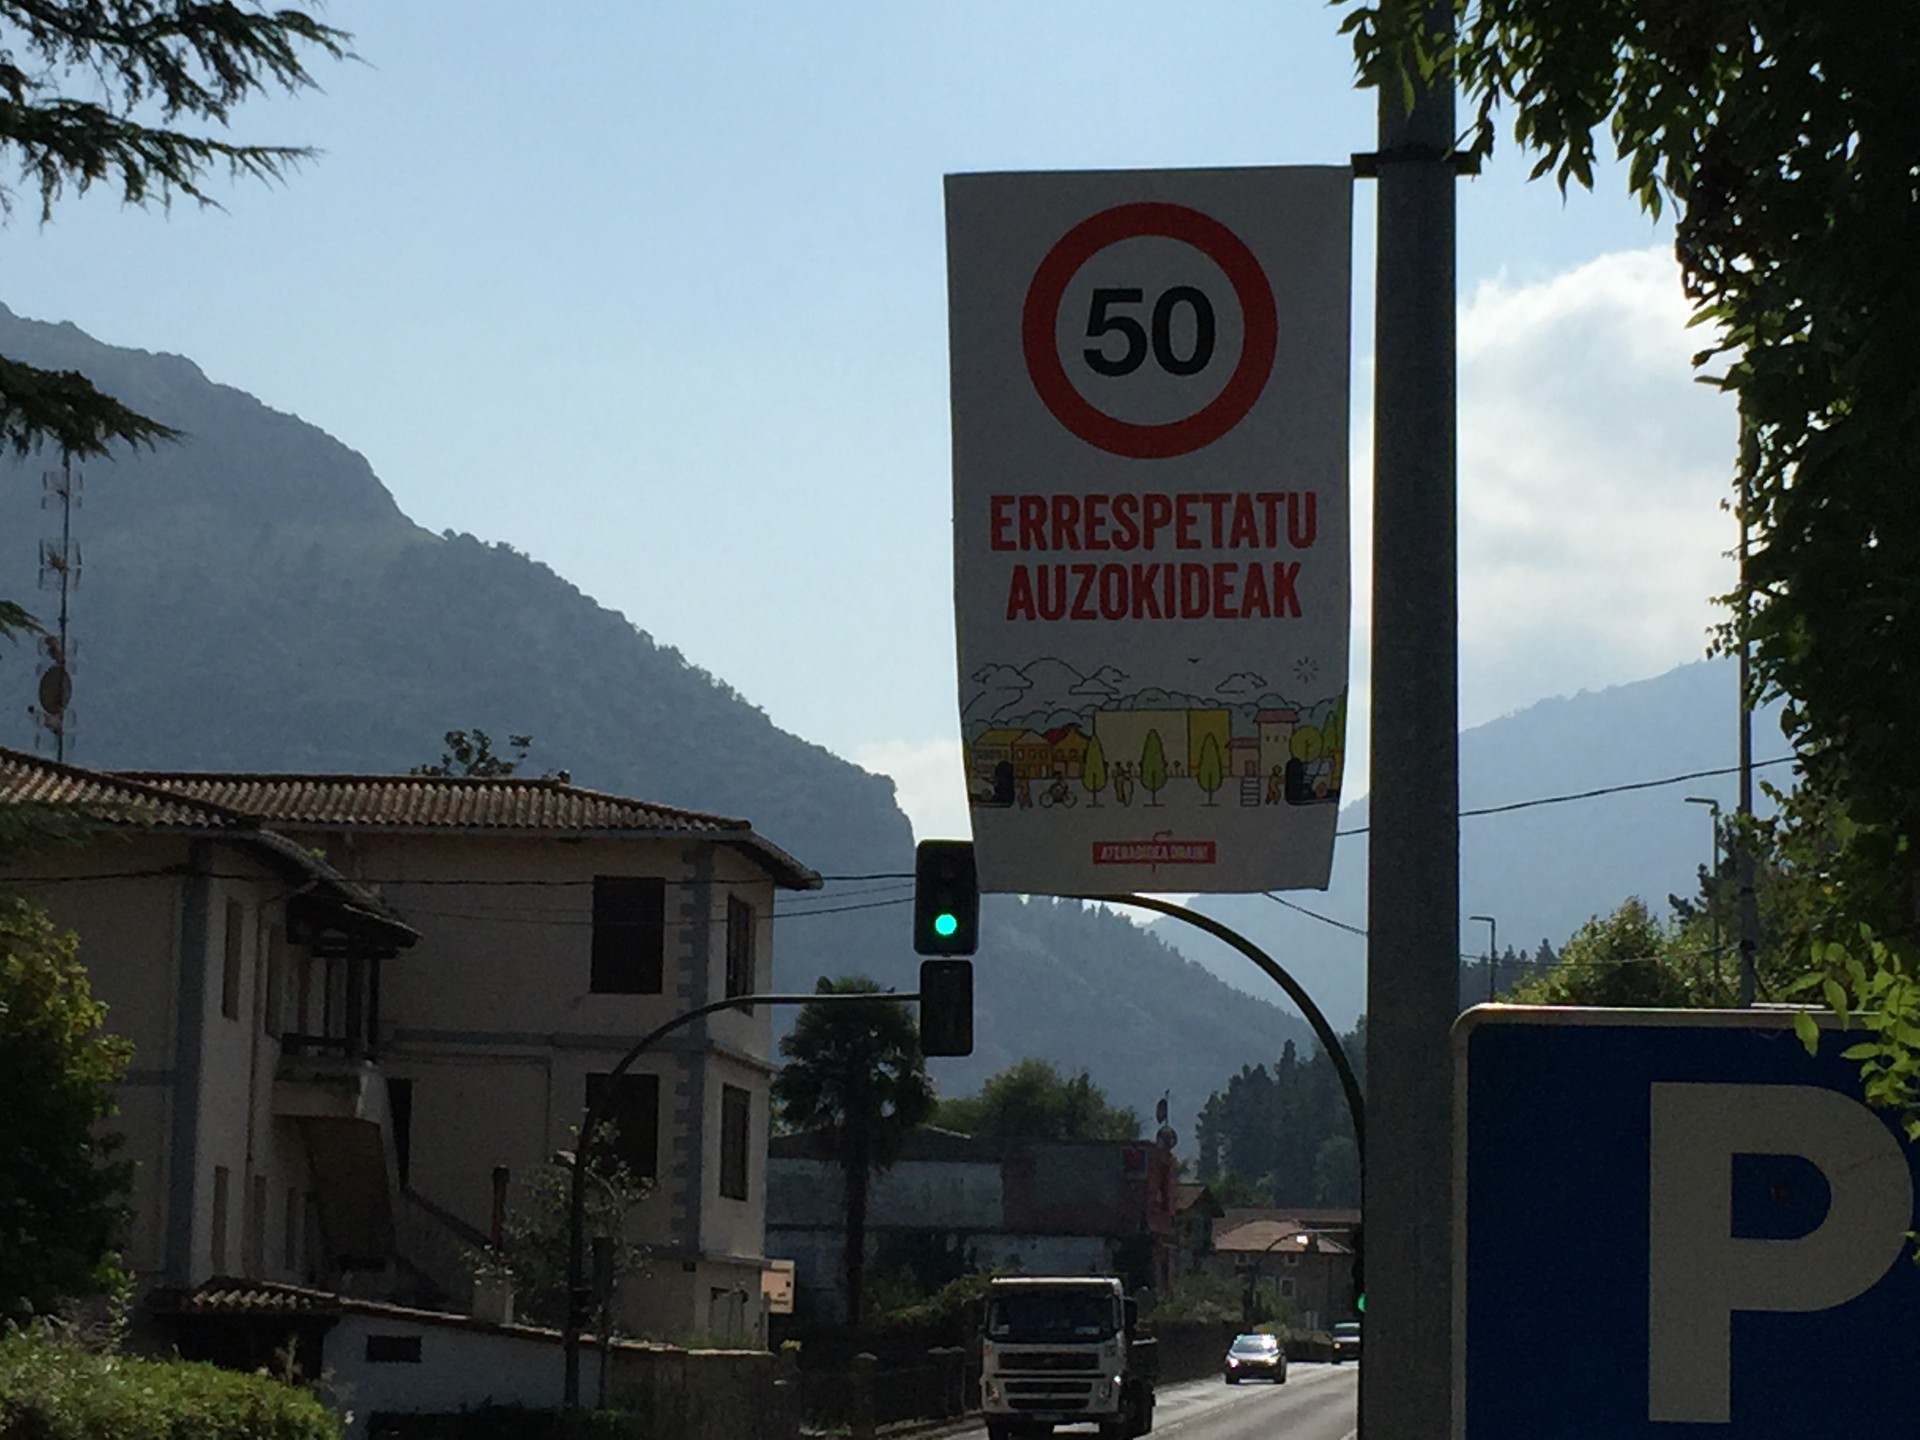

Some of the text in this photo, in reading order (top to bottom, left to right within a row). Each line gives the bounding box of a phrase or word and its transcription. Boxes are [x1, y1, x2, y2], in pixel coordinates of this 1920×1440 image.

[1083, 285, 1216, 376] 50
[990, 492, 1317, 551] ERRESPETATU
[1006, 562, 1302, 620] AUZOKIDEAK
[1648, 1081, 1914, 1424] P
